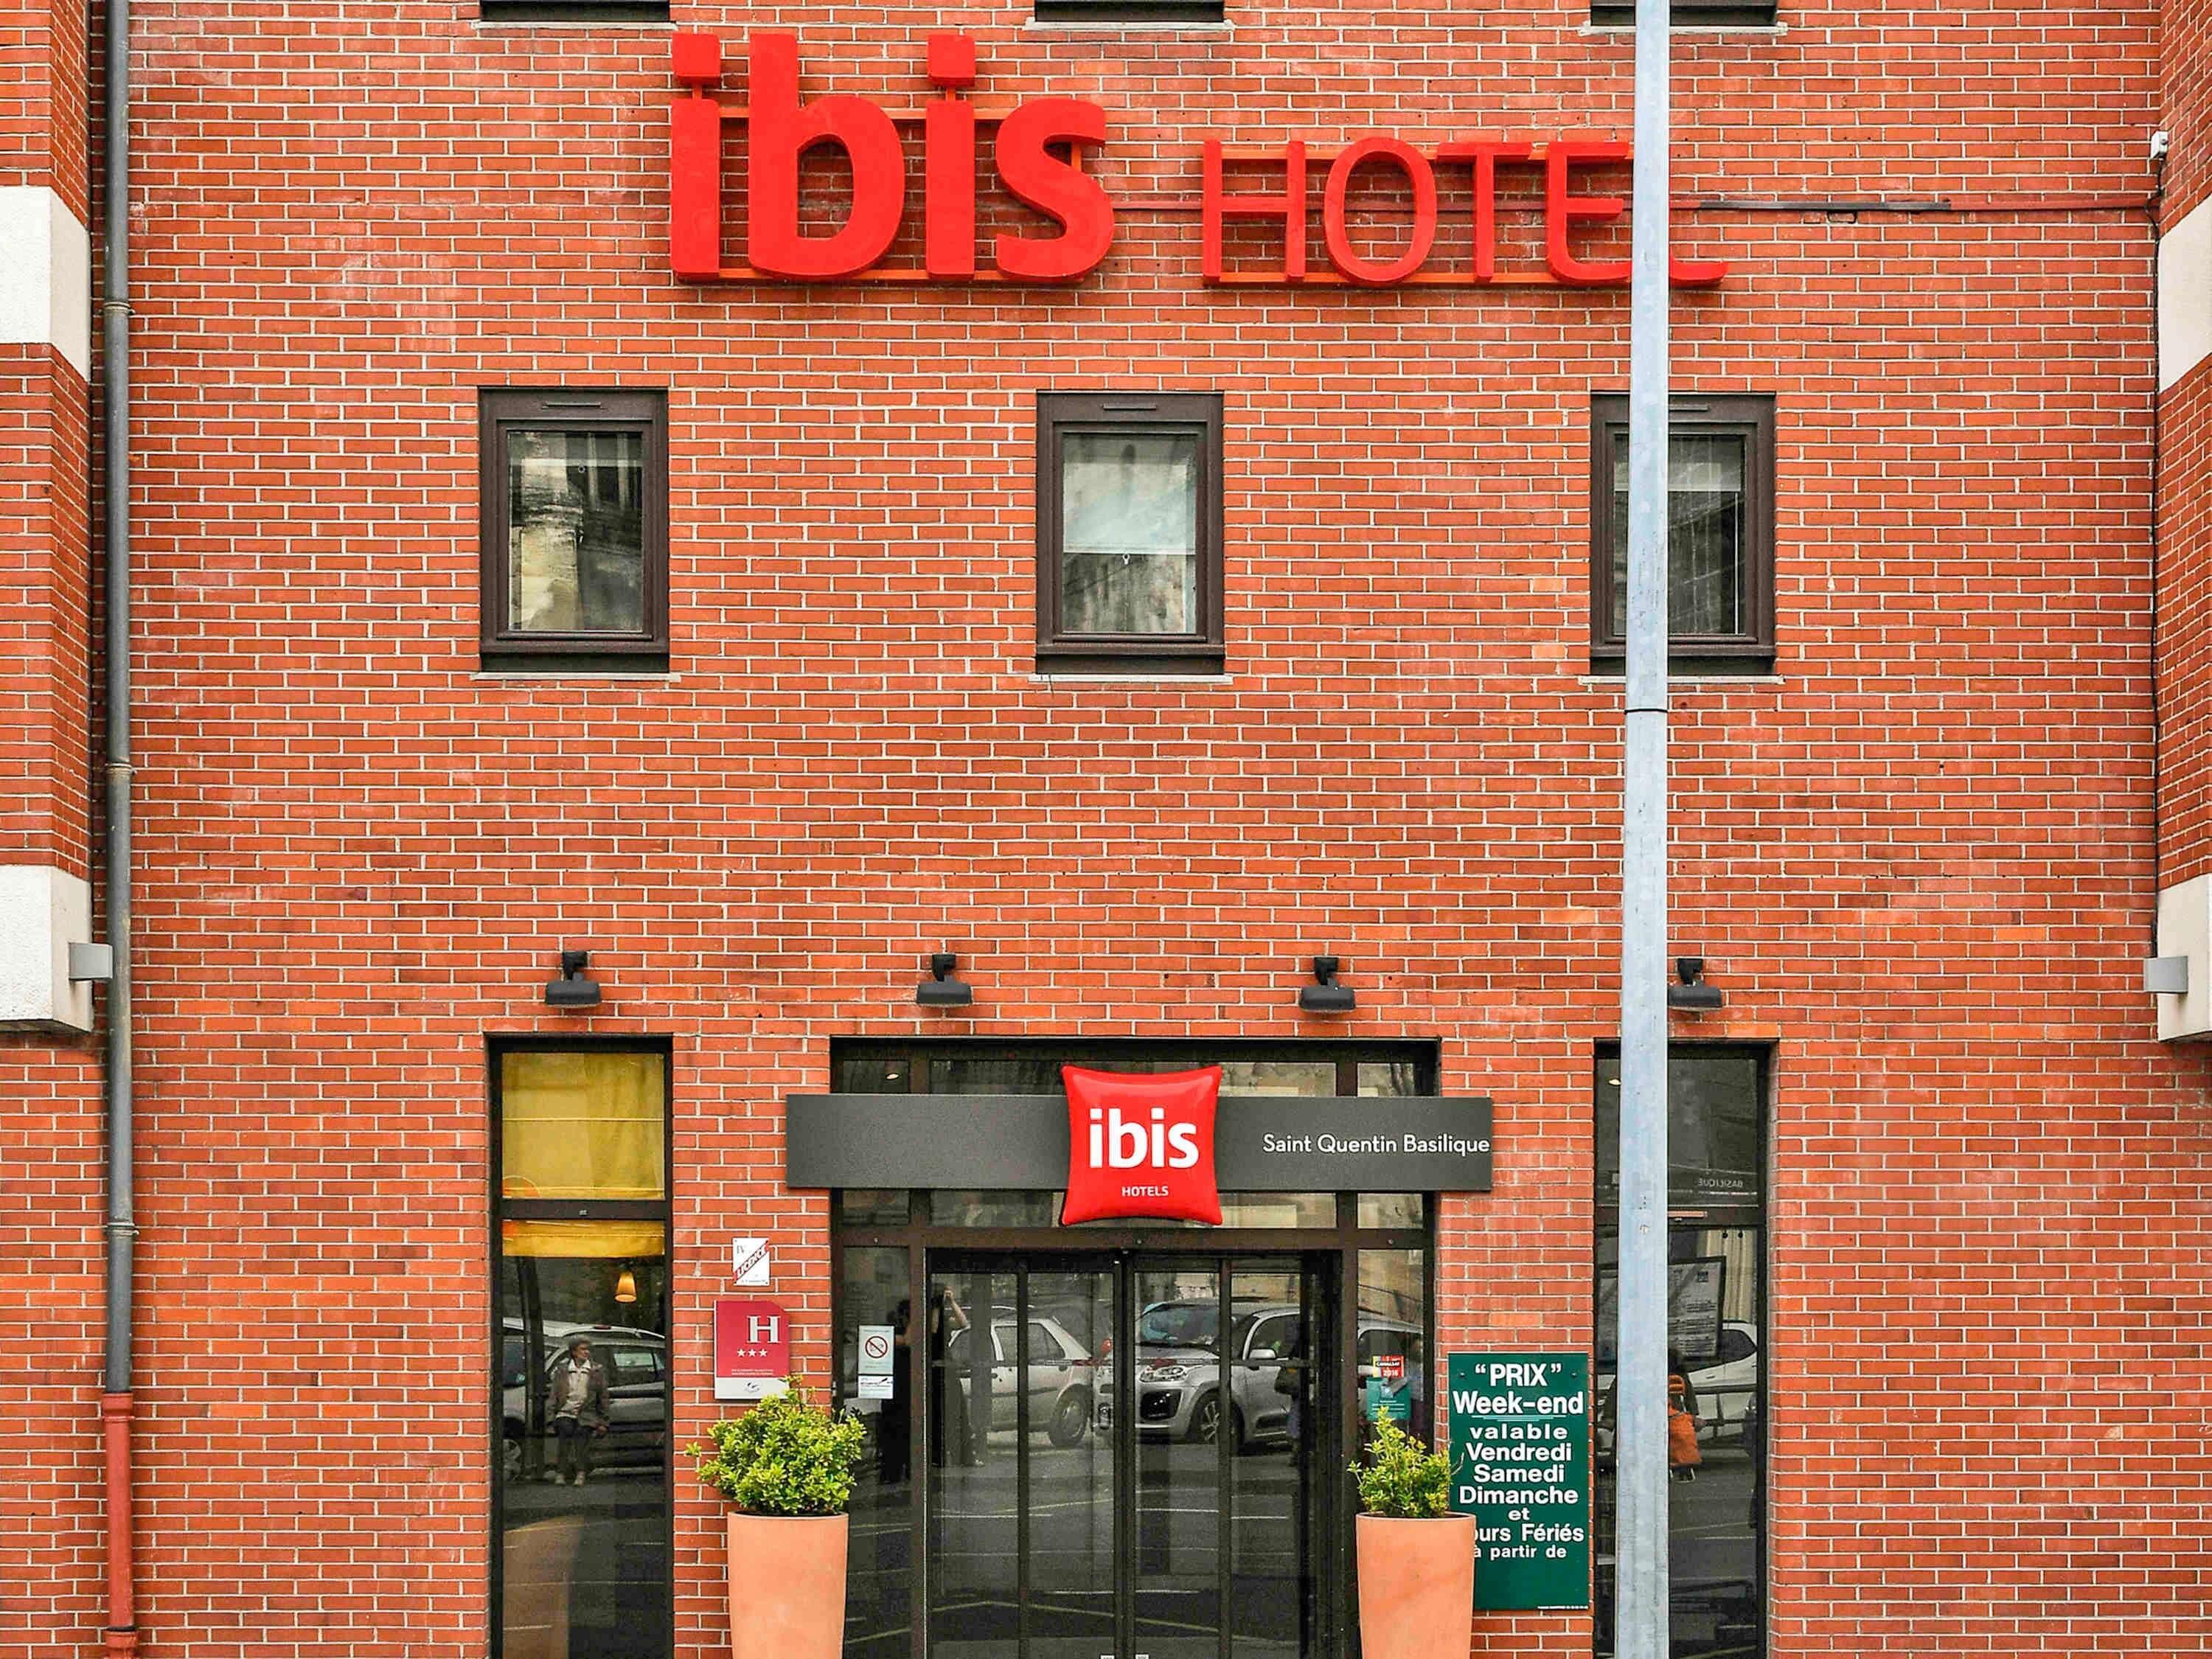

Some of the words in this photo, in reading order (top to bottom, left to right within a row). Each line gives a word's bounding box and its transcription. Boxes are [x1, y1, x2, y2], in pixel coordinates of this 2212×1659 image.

[669, 34, 1115, 285] ibis
[1089, 1107, 1200, 1169] ibis
[1262, 1133, 1312, 1153] Saint
[1317, 1133, 1398, 1155] Quentin
[1402, 1133, 1490, 1158] Basilique
[1121, 1185, 1169, 1197] HOTELS
[747, 1315, 782, 1343] H
[1453, 1390, 1584, 1415] Week-end
[1470, 1423, 1568, 1441] valable
[1465, 1441, 1572, 1462] Vendredi
[1473, 1464, 1565, 1484] Samedi
[1458, 1484, 1579, 1505] Dimanche
[1507, 1506, 1531, 1521] et
[1475, 1527, 1512, 1543] urs
[1521, 1523, 1585, 1543] Fériés
[1489, 1544, 1537, 1562] partir
[1545, 1543, 1568, 1559] de
